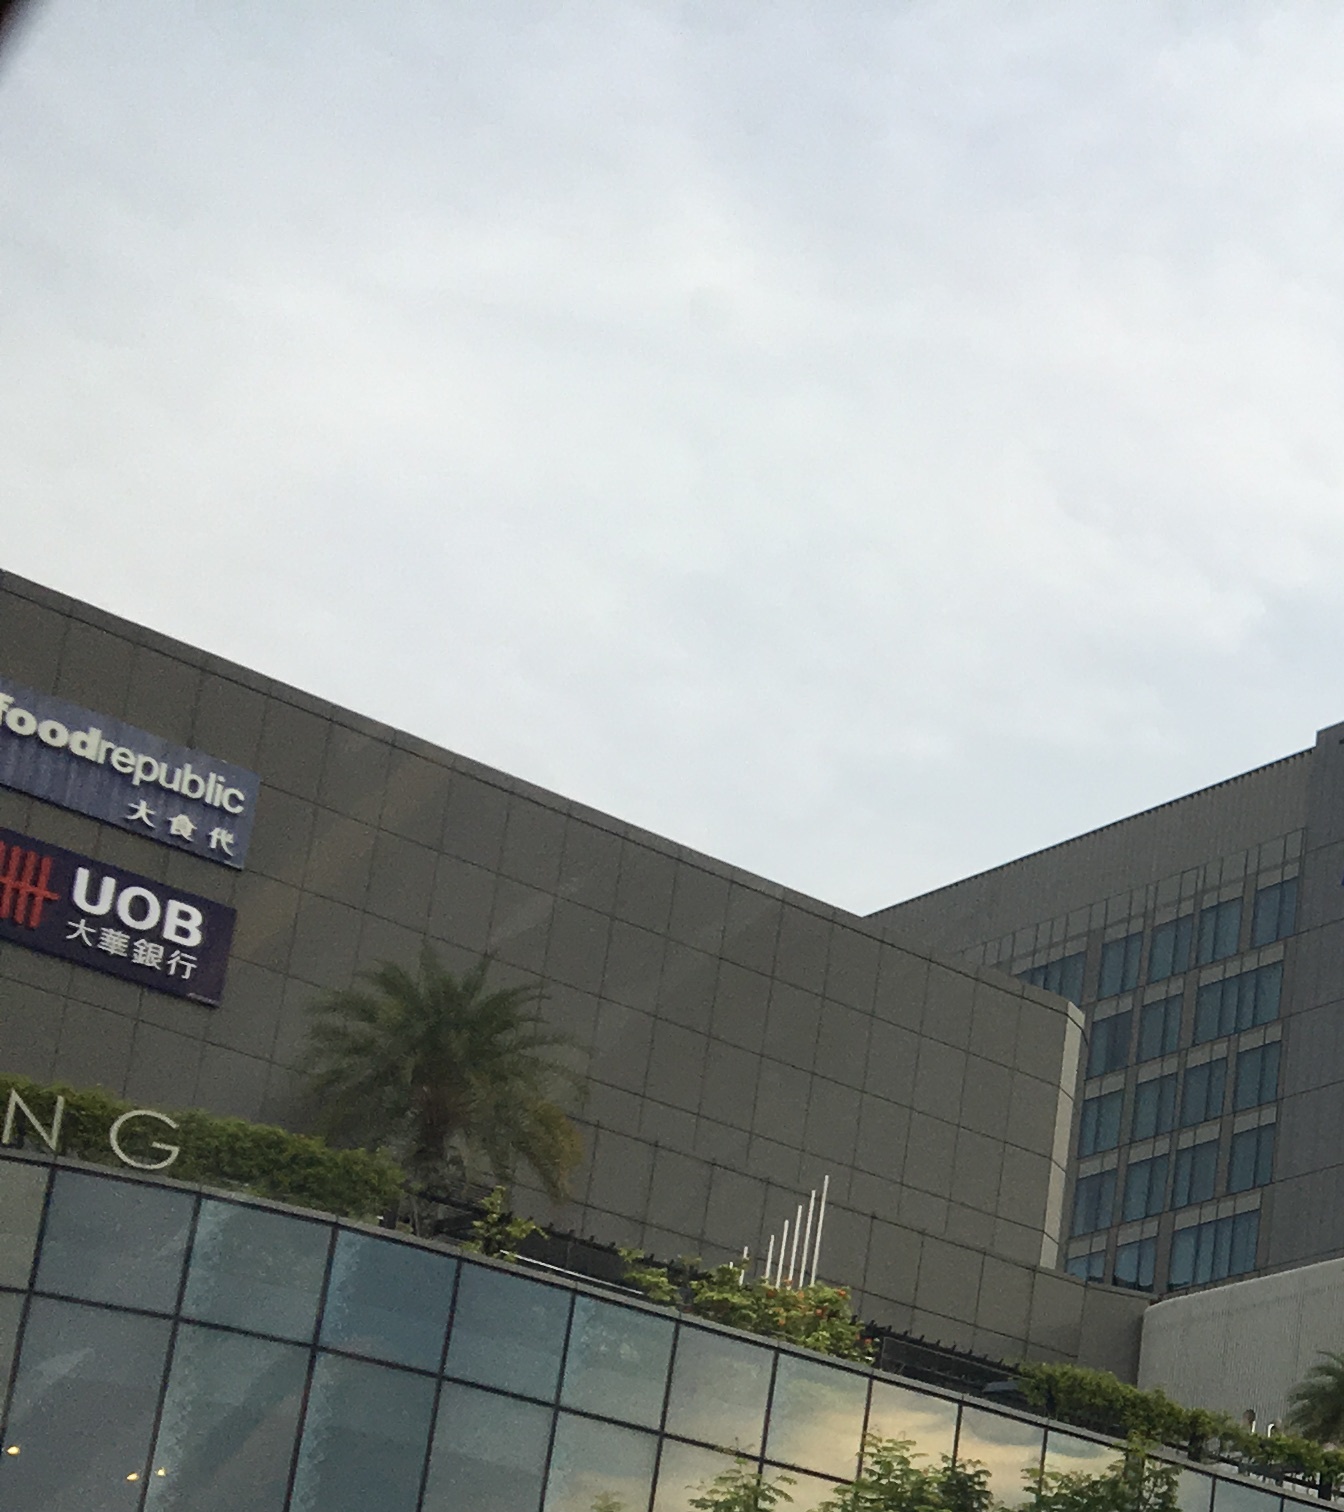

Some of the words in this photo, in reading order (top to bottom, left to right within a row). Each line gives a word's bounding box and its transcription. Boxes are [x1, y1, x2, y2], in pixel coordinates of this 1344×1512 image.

[125, 800, 235, 857] 大食代
[72, 866, 204, 947] UOB
[66, 919, 199, 981] 大華銀行
